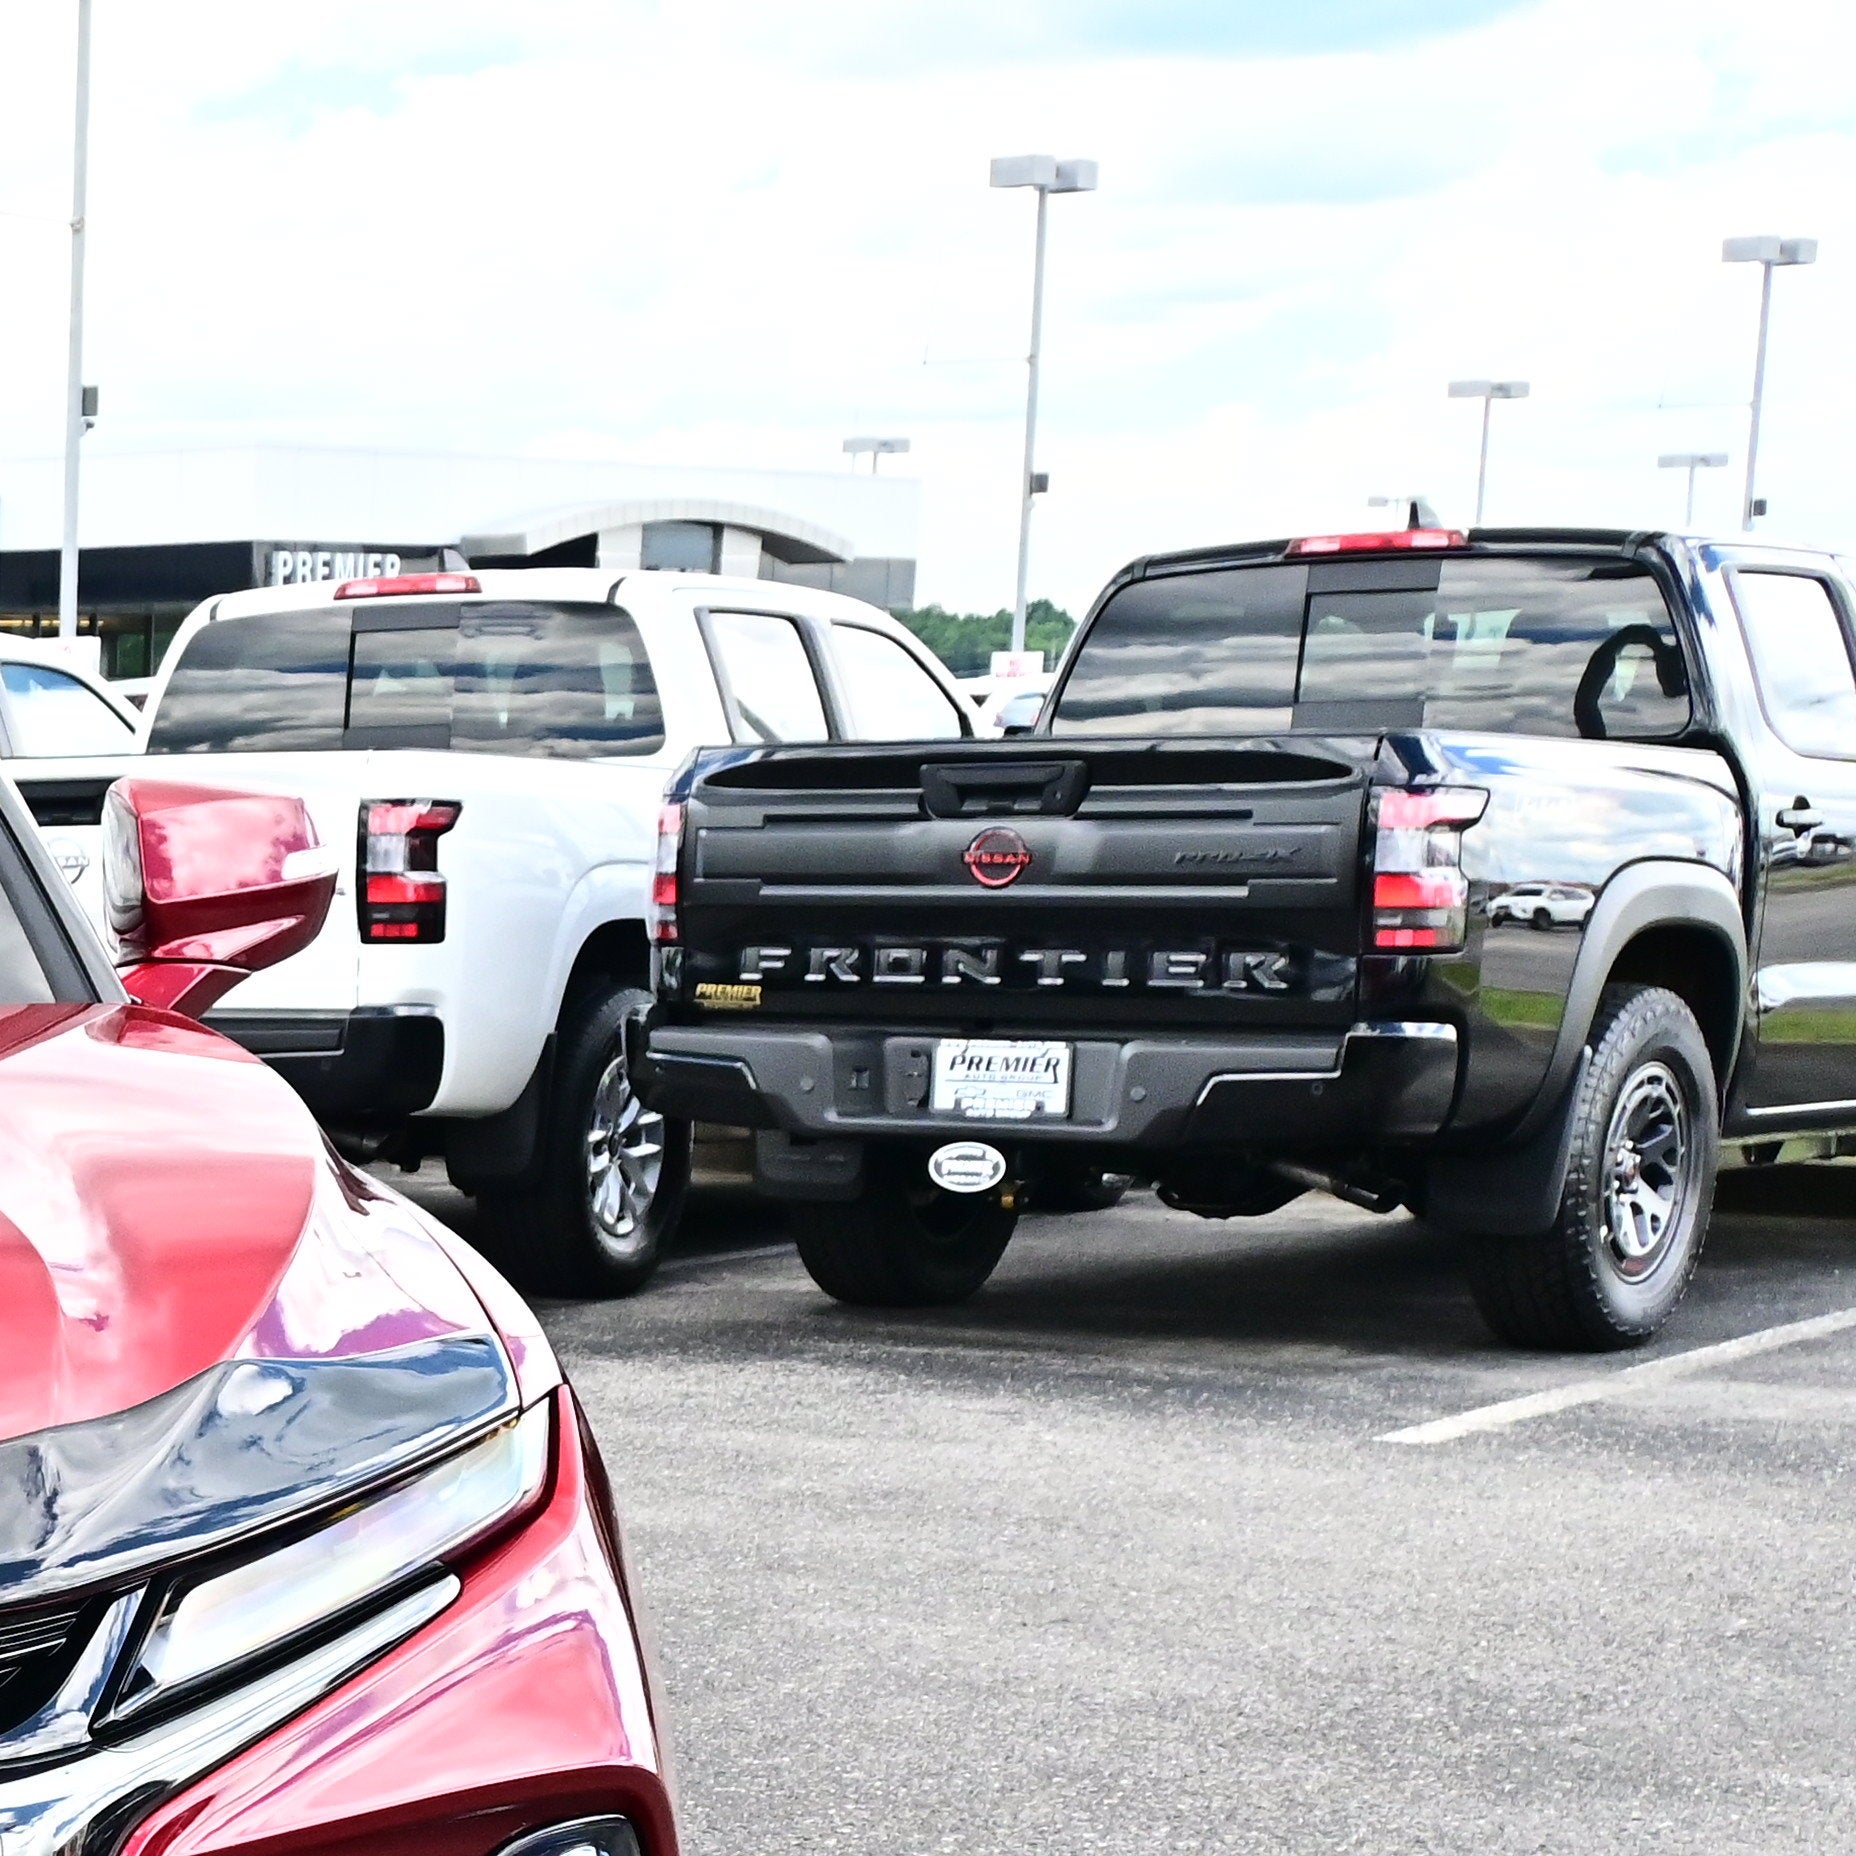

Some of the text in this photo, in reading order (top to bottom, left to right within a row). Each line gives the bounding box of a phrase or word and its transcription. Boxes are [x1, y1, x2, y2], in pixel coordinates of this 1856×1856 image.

[273, 550, 401, 586] PREMIER
[964, 852, 1030, 864] NISSAN
[740, 946, 1288, 989] FRONTIER
[696, 983, 762, 1003] PREMIER
[949, 1054, 1061, 1083] PREMIER
